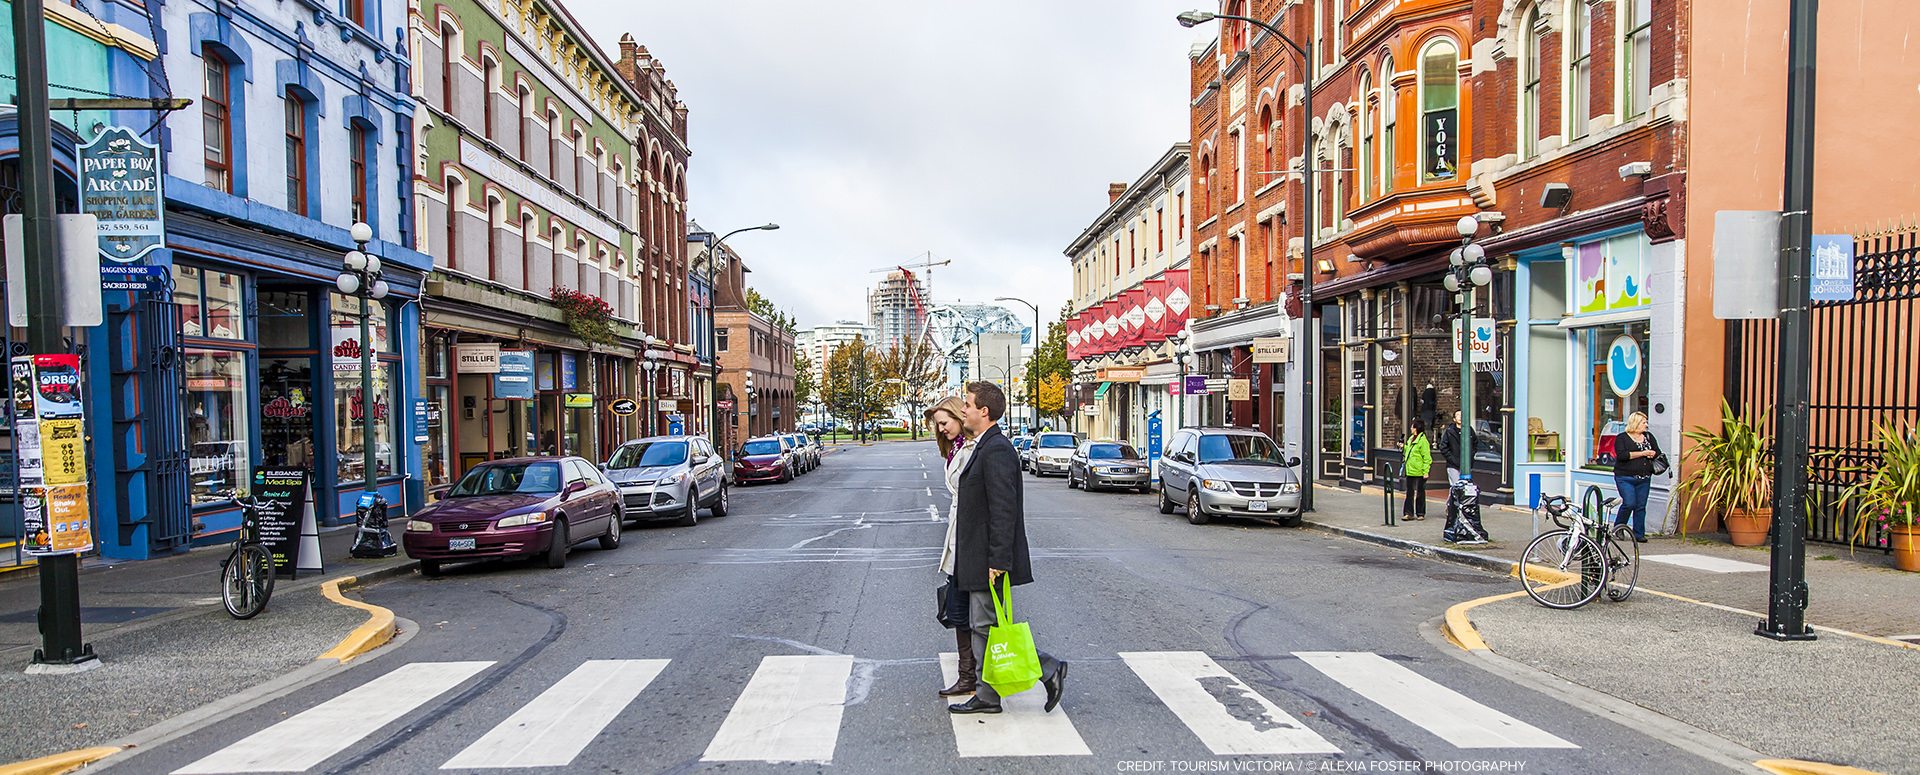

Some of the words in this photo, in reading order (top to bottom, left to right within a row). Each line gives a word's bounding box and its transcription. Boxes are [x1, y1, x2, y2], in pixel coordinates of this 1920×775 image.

[1436, 117, 1447, 170] YOGA
[84, 157, 126, 172] PAPER
[130, 157, 155, 173] BOX
[85, 176, 156, 192] ARCADE
[489, 158, 533, 195] GRAND
[538, 187, 583, 225] CENTRAL
[85, 196, 129, 205] SHOPPING
[131, 196, 155, 205] LANE
[115, 209, 157, 219] GARDENS
[1813, 286, 1852, 294] JOHNSON
[341, 338, 358, 349] oh
[333, 345, 375, 359] Sugr
[1378, 365, 1404, 377] SUASION
[272, 396, 290, 409] oh
[264, 403, 307, 418] Sugar
